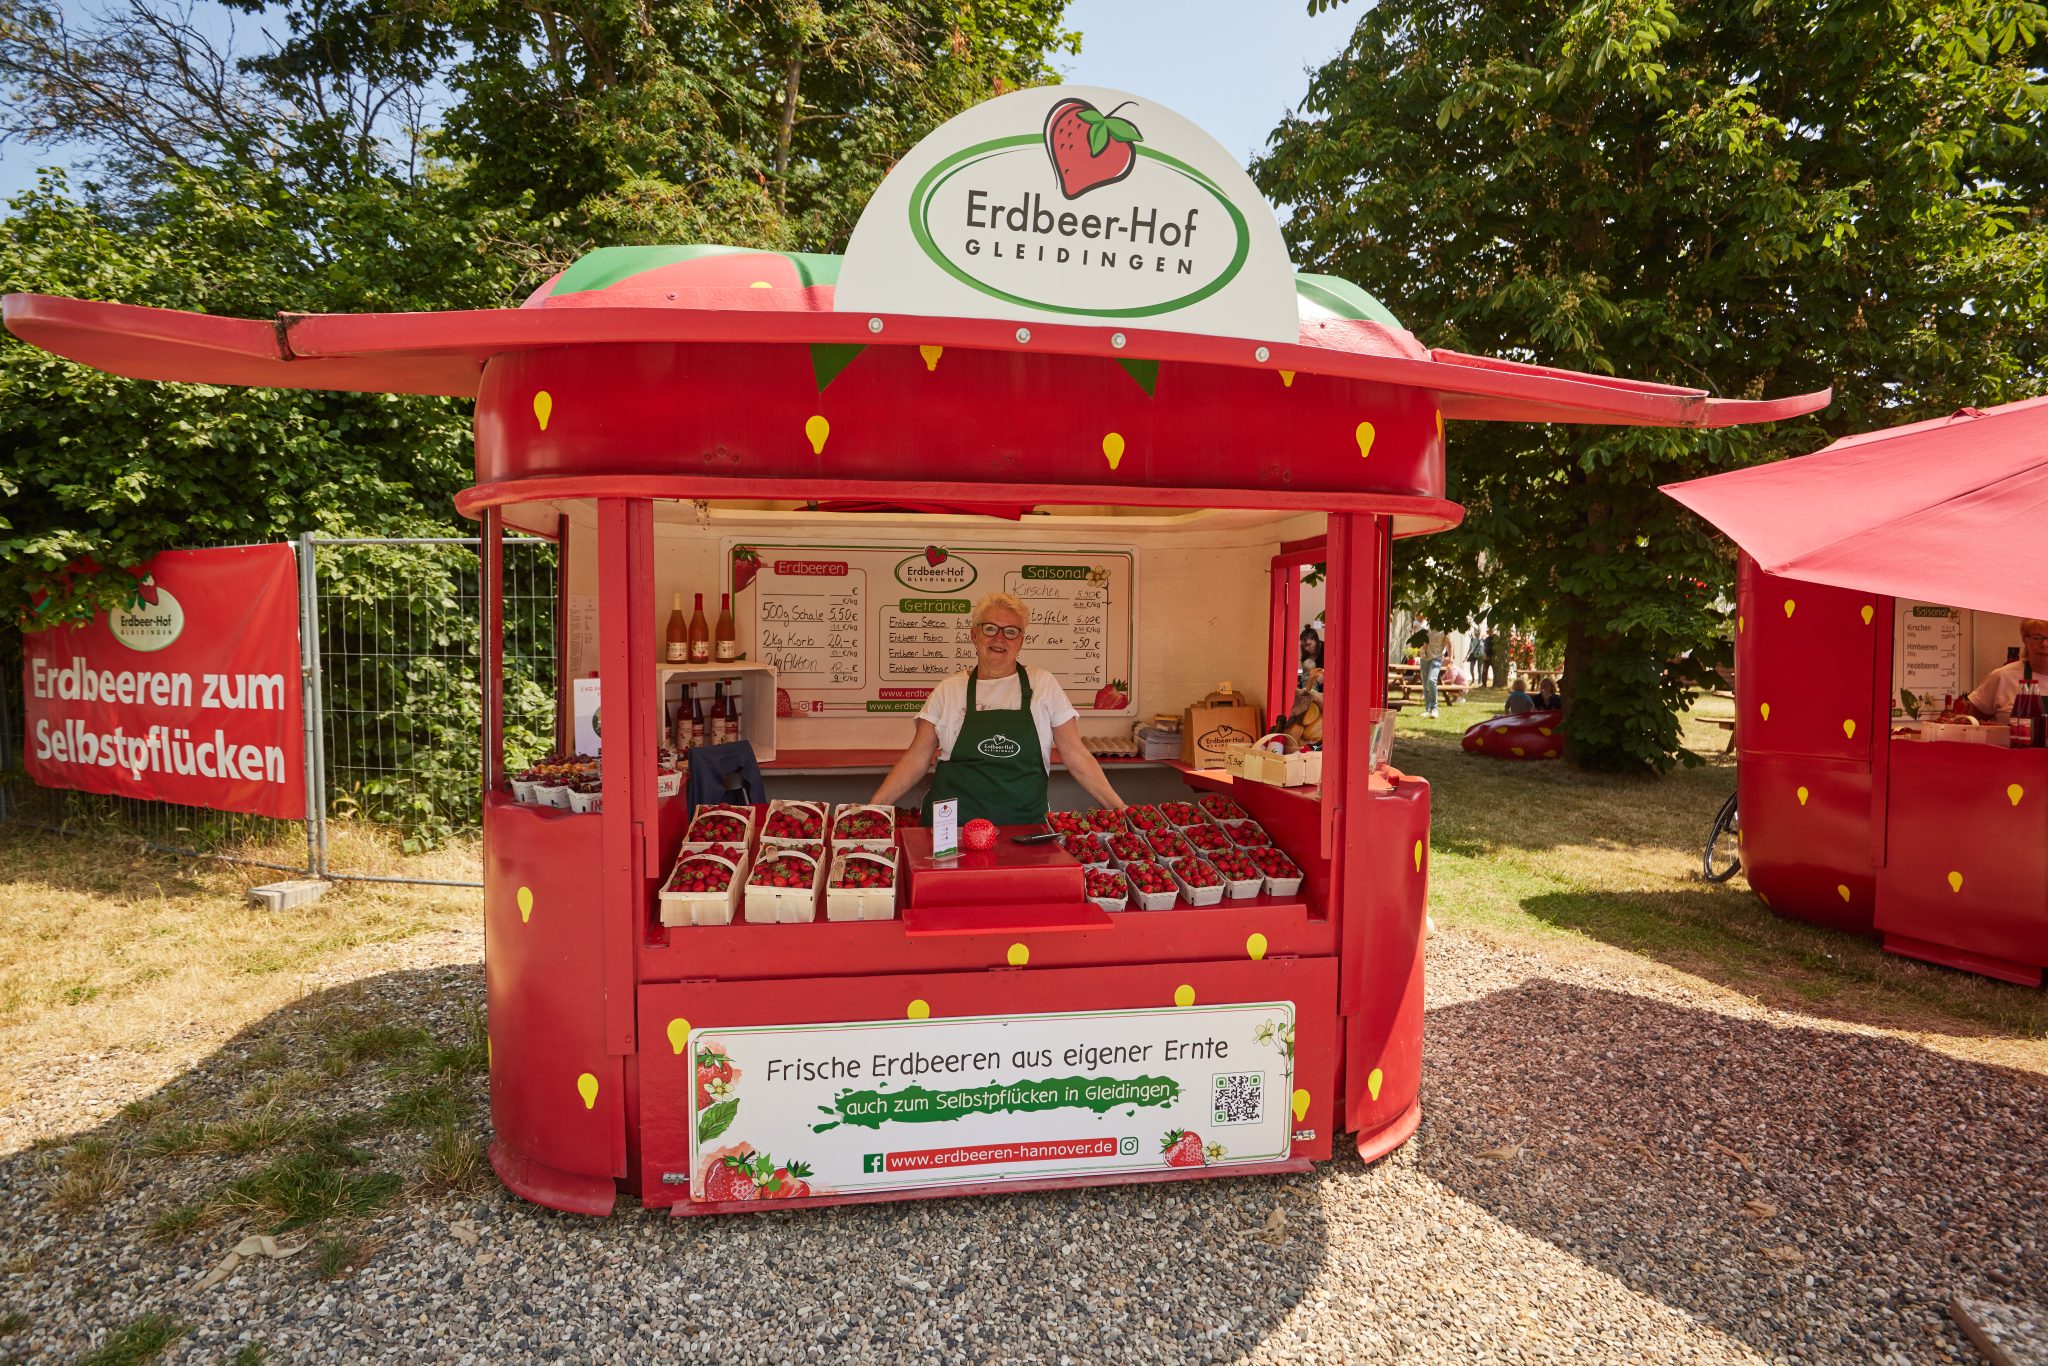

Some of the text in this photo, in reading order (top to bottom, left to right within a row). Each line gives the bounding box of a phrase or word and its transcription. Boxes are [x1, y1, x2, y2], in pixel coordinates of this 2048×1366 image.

[966, 189, 1198, 247] Erdbeer-Hof
[965, 239, 1194, 275] GLEIDINGEN
[778, 562, 844, 575] Erdbeeren
[907, 566, 965, 576] Erdbeer-Hof
[1028, 566, 1085, 579] Saisonal
[760, 601, 790, 628] 500g
[904, 599, 966, 612] Getränke
[1031, 608, 1069, 627] toffeln
[121, 615, 171, 627] Erdbeer-Hof
[788, 631, 815, 647] Korb
[32, 656, 285, 711] Erdbeeren zum
[36, 718, 285, 784] Selbstpflücken
[767, 1037, 1229, 1081] Frische Erdbeeren aus eigener Ernte
[846, 1083, 1170, 1116] auch zum Selbstpflücken in Gleidingen
[891, 1140, 1113, 1168] www.erdbeeren-hannover.de
